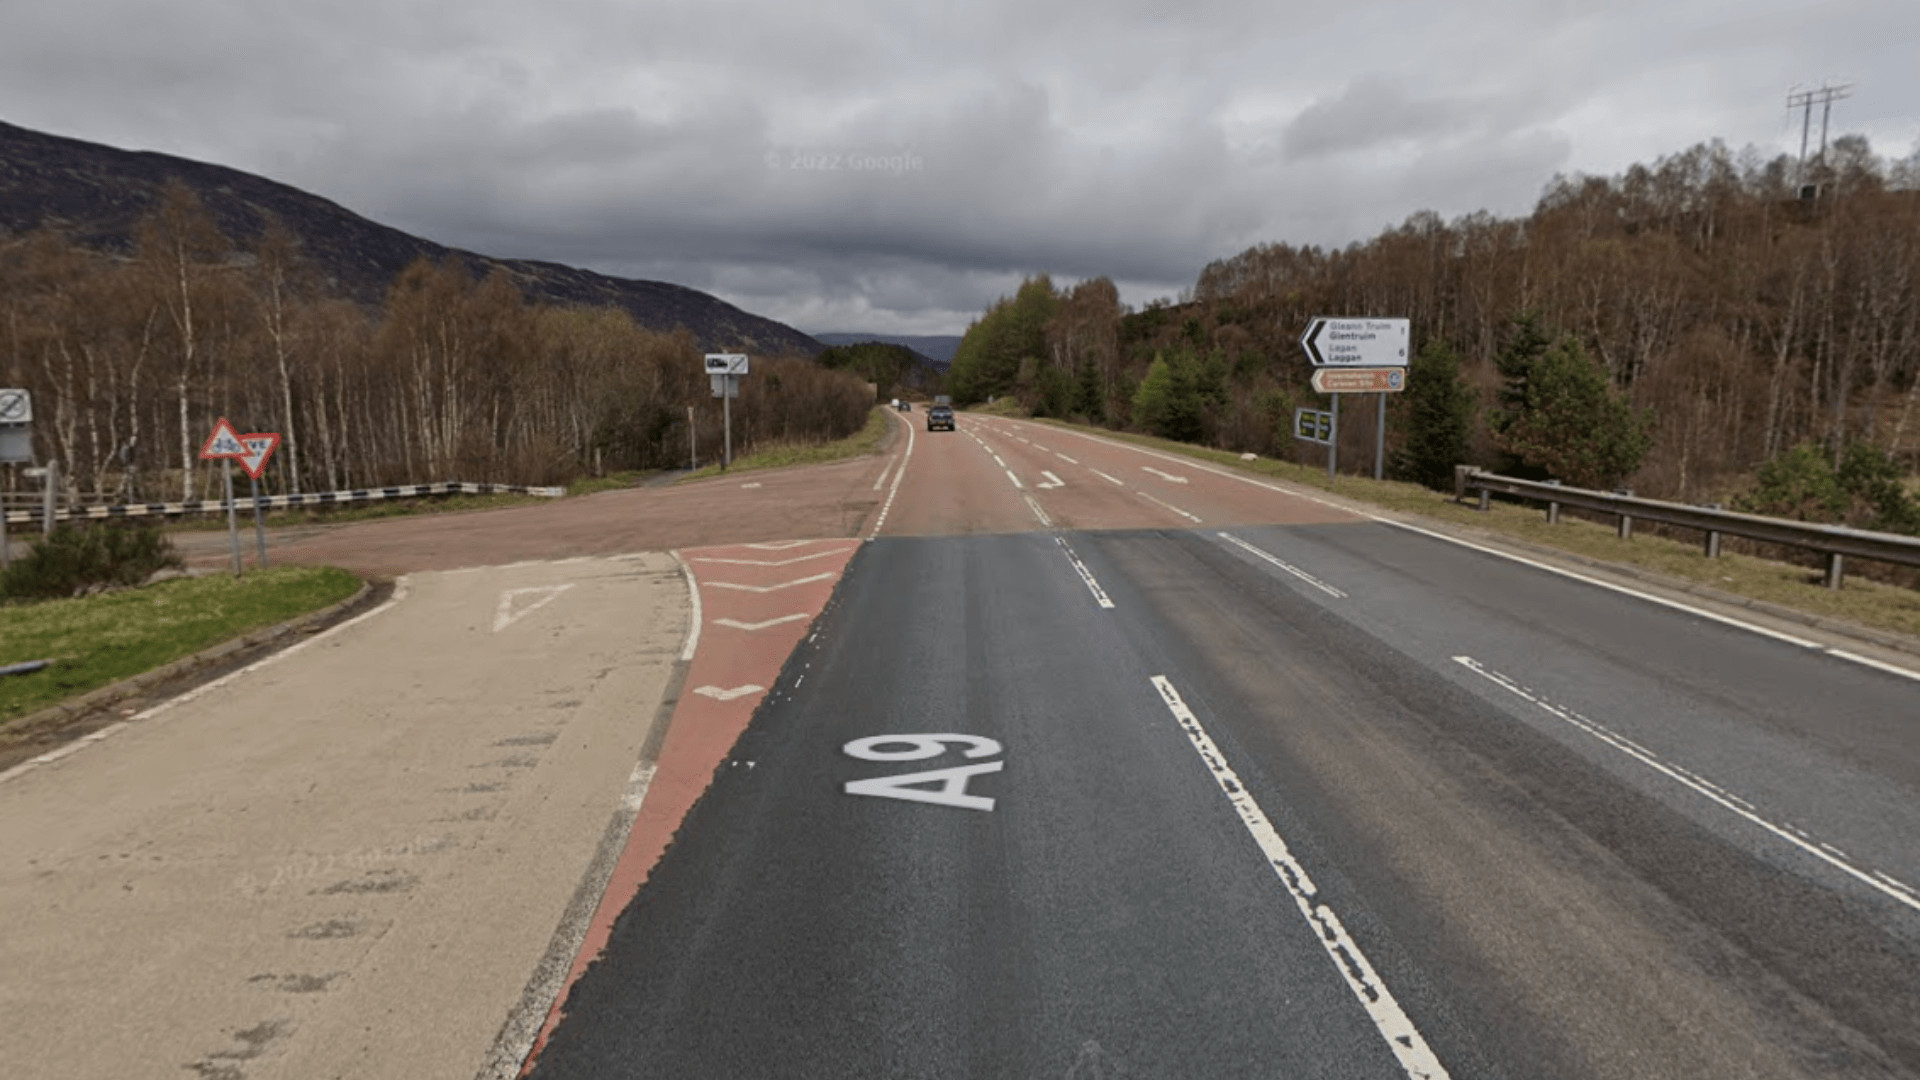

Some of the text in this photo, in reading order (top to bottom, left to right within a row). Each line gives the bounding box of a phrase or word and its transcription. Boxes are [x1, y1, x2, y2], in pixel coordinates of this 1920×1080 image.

[1329, 331, 1377, 340] Glentruim
[1328, 353, 1362, 363] Laggan
[843, 733, 1003, 812] A9
